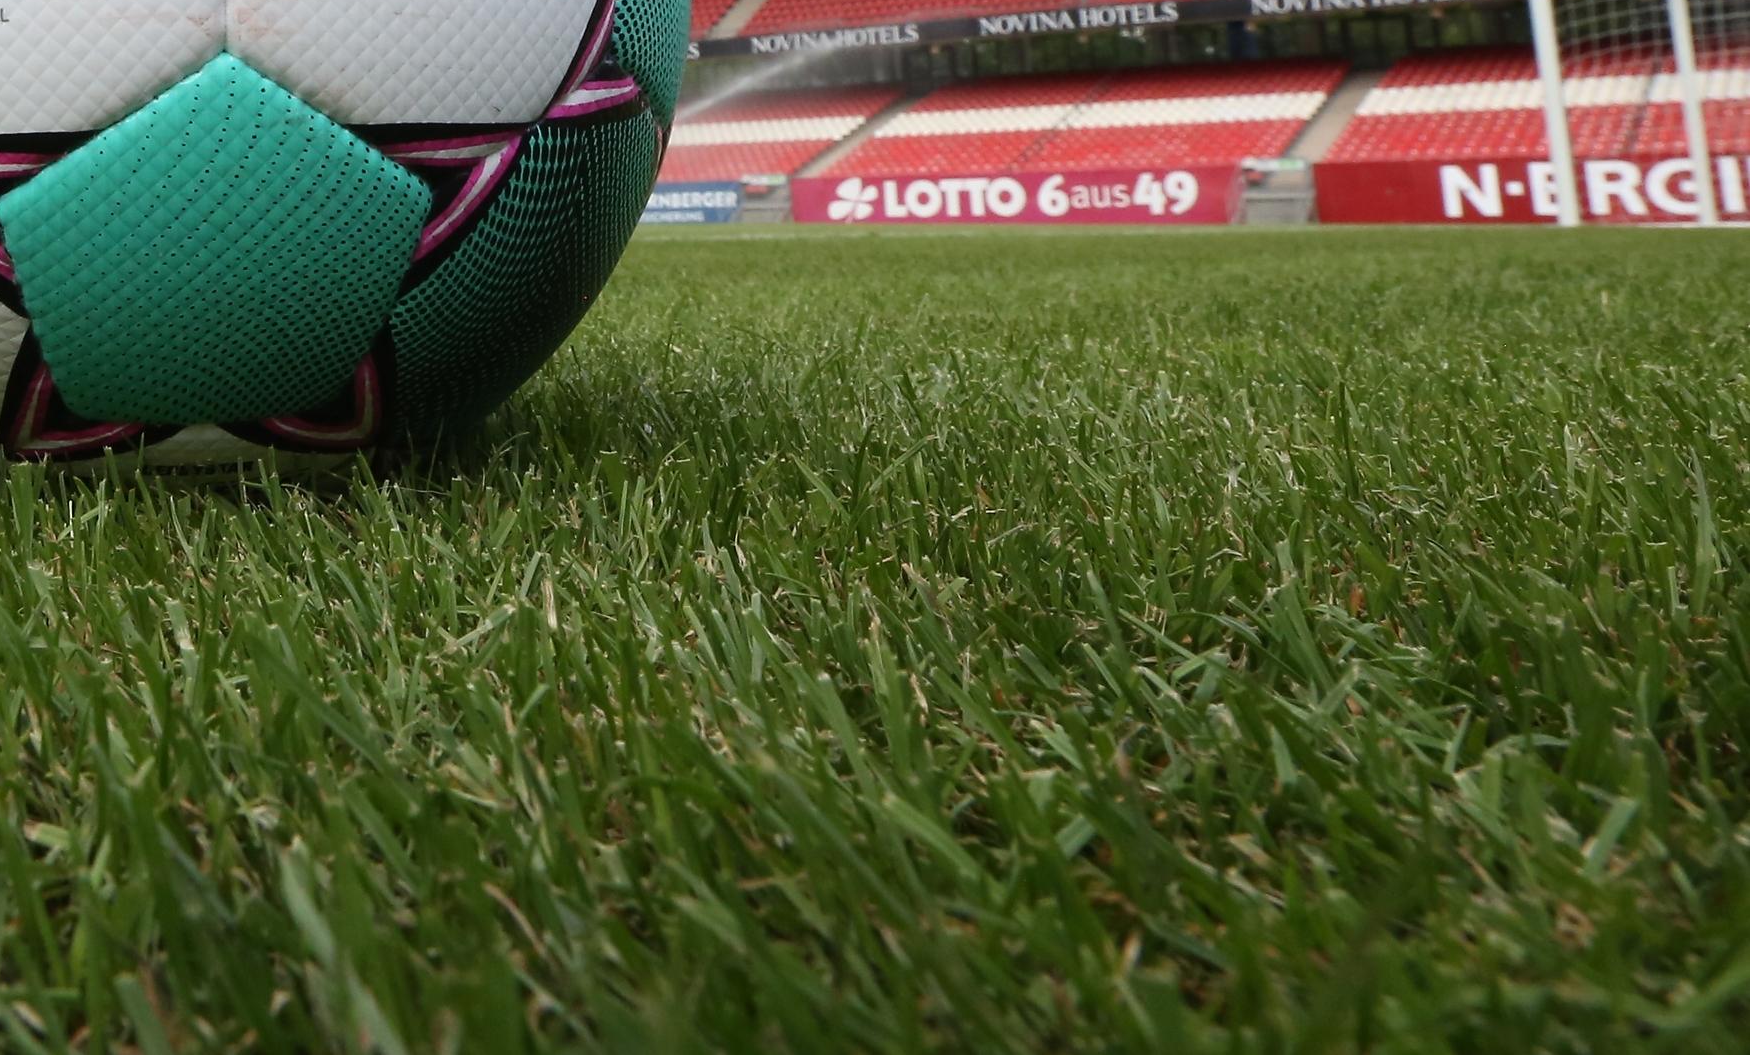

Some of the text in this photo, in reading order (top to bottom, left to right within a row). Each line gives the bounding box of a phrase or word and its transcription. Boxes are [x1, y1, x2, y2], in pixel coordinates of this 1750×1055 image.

[979, 1, 1179, 36] NOVINA HOTELS
[751, 23, 920, 55] NOVINA HOTELS
[883, 176, 1027, 218] LOTTO
